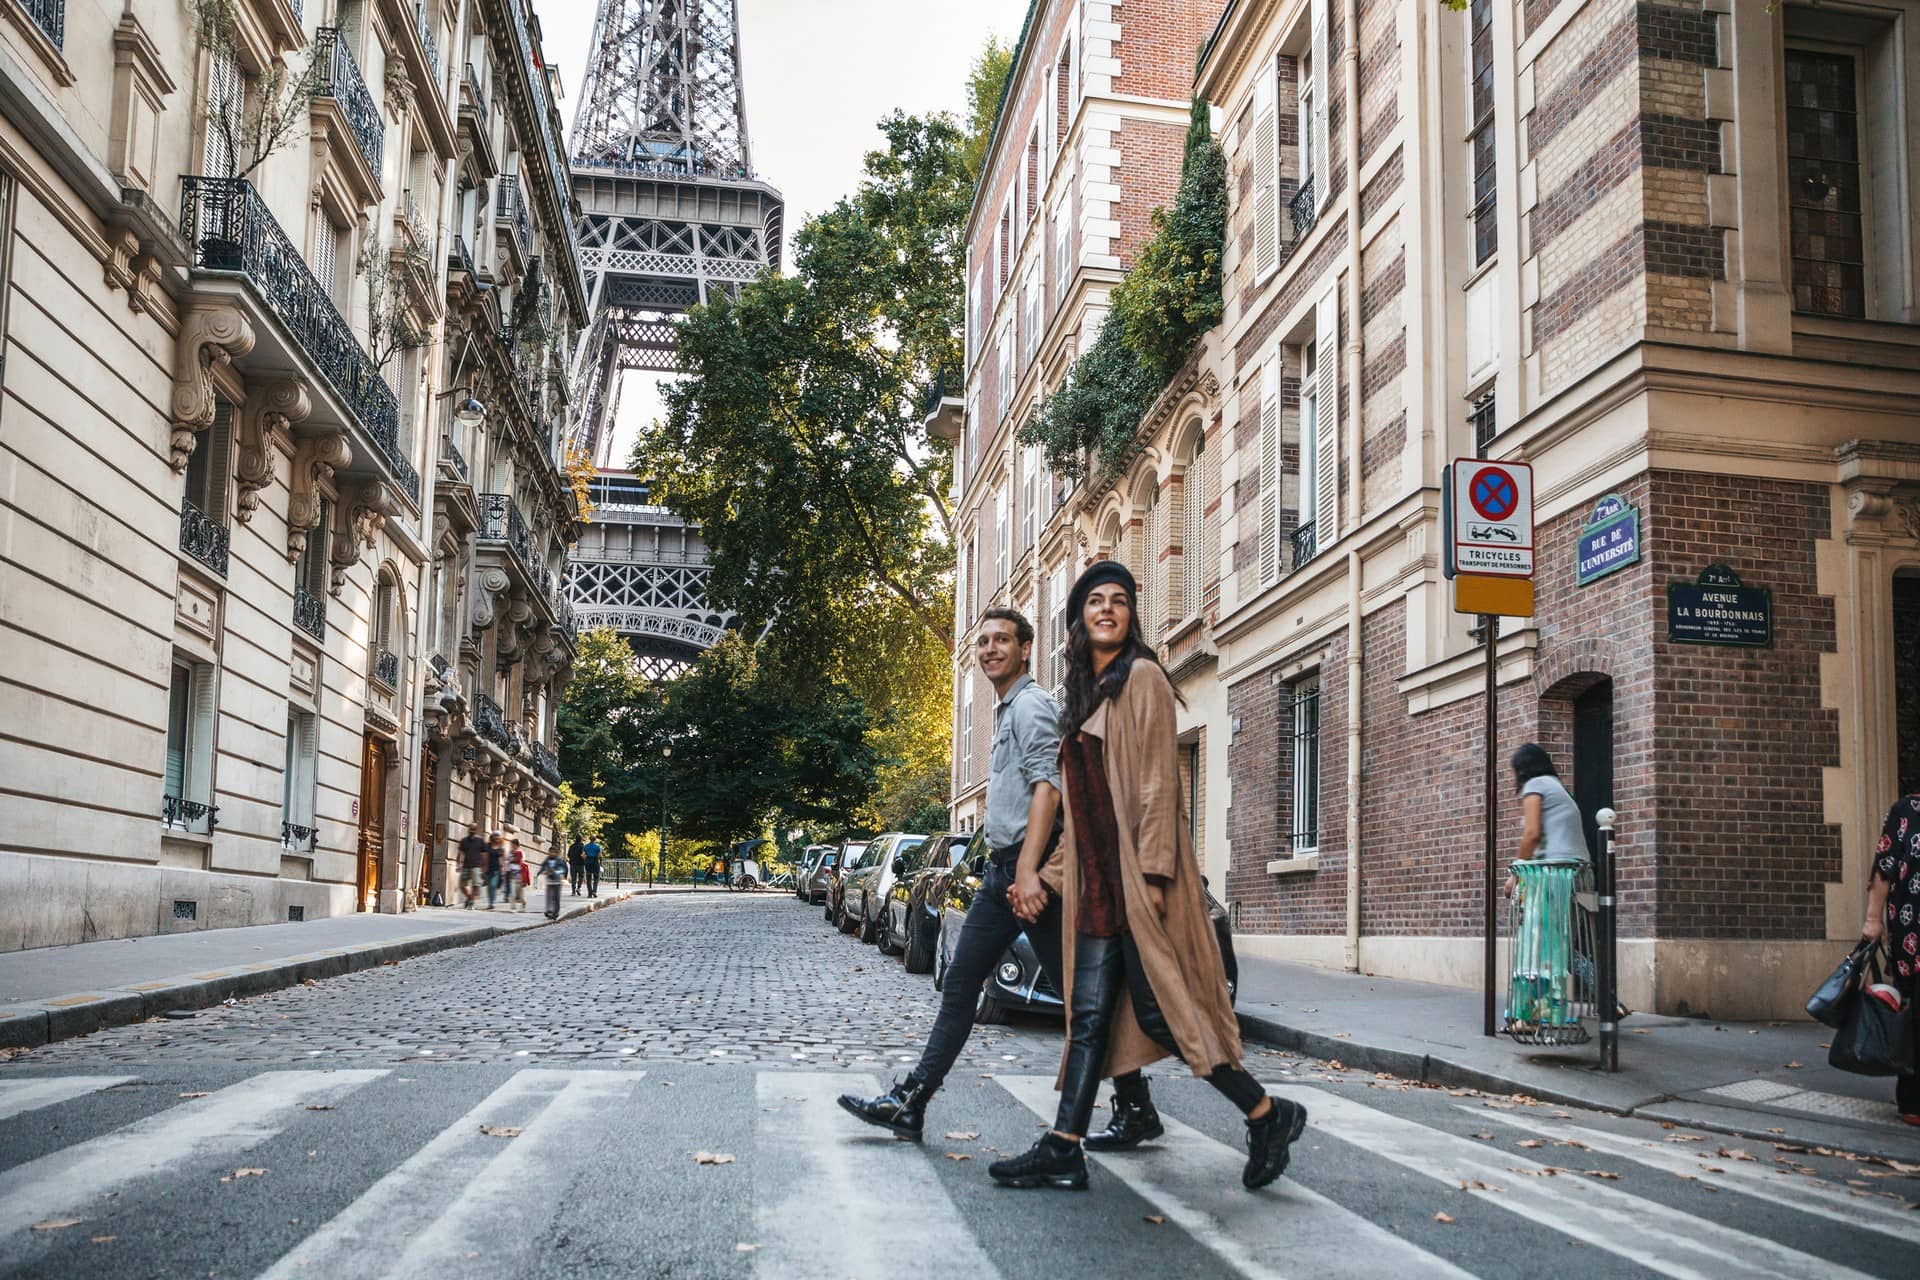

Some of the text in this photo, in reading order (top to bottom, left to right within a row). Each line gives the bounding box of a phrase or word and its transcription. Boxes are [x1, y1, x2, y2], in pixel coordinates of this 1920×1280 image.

[1591, 529, 1622, 551] RUE DE
[1469, 550, 1521, 561] TRICYCLES
[1581, 537, 1634, 573] L'UNIVERSITÉ
[1459, 559, 1490, 567] TRANSPORT
[1500, 562, 1531, 570] PERSONNES
[1702, 592, 1739, 604] AVENUE
[1677, 608, 1764, 621] LA BOURDONNAIS
